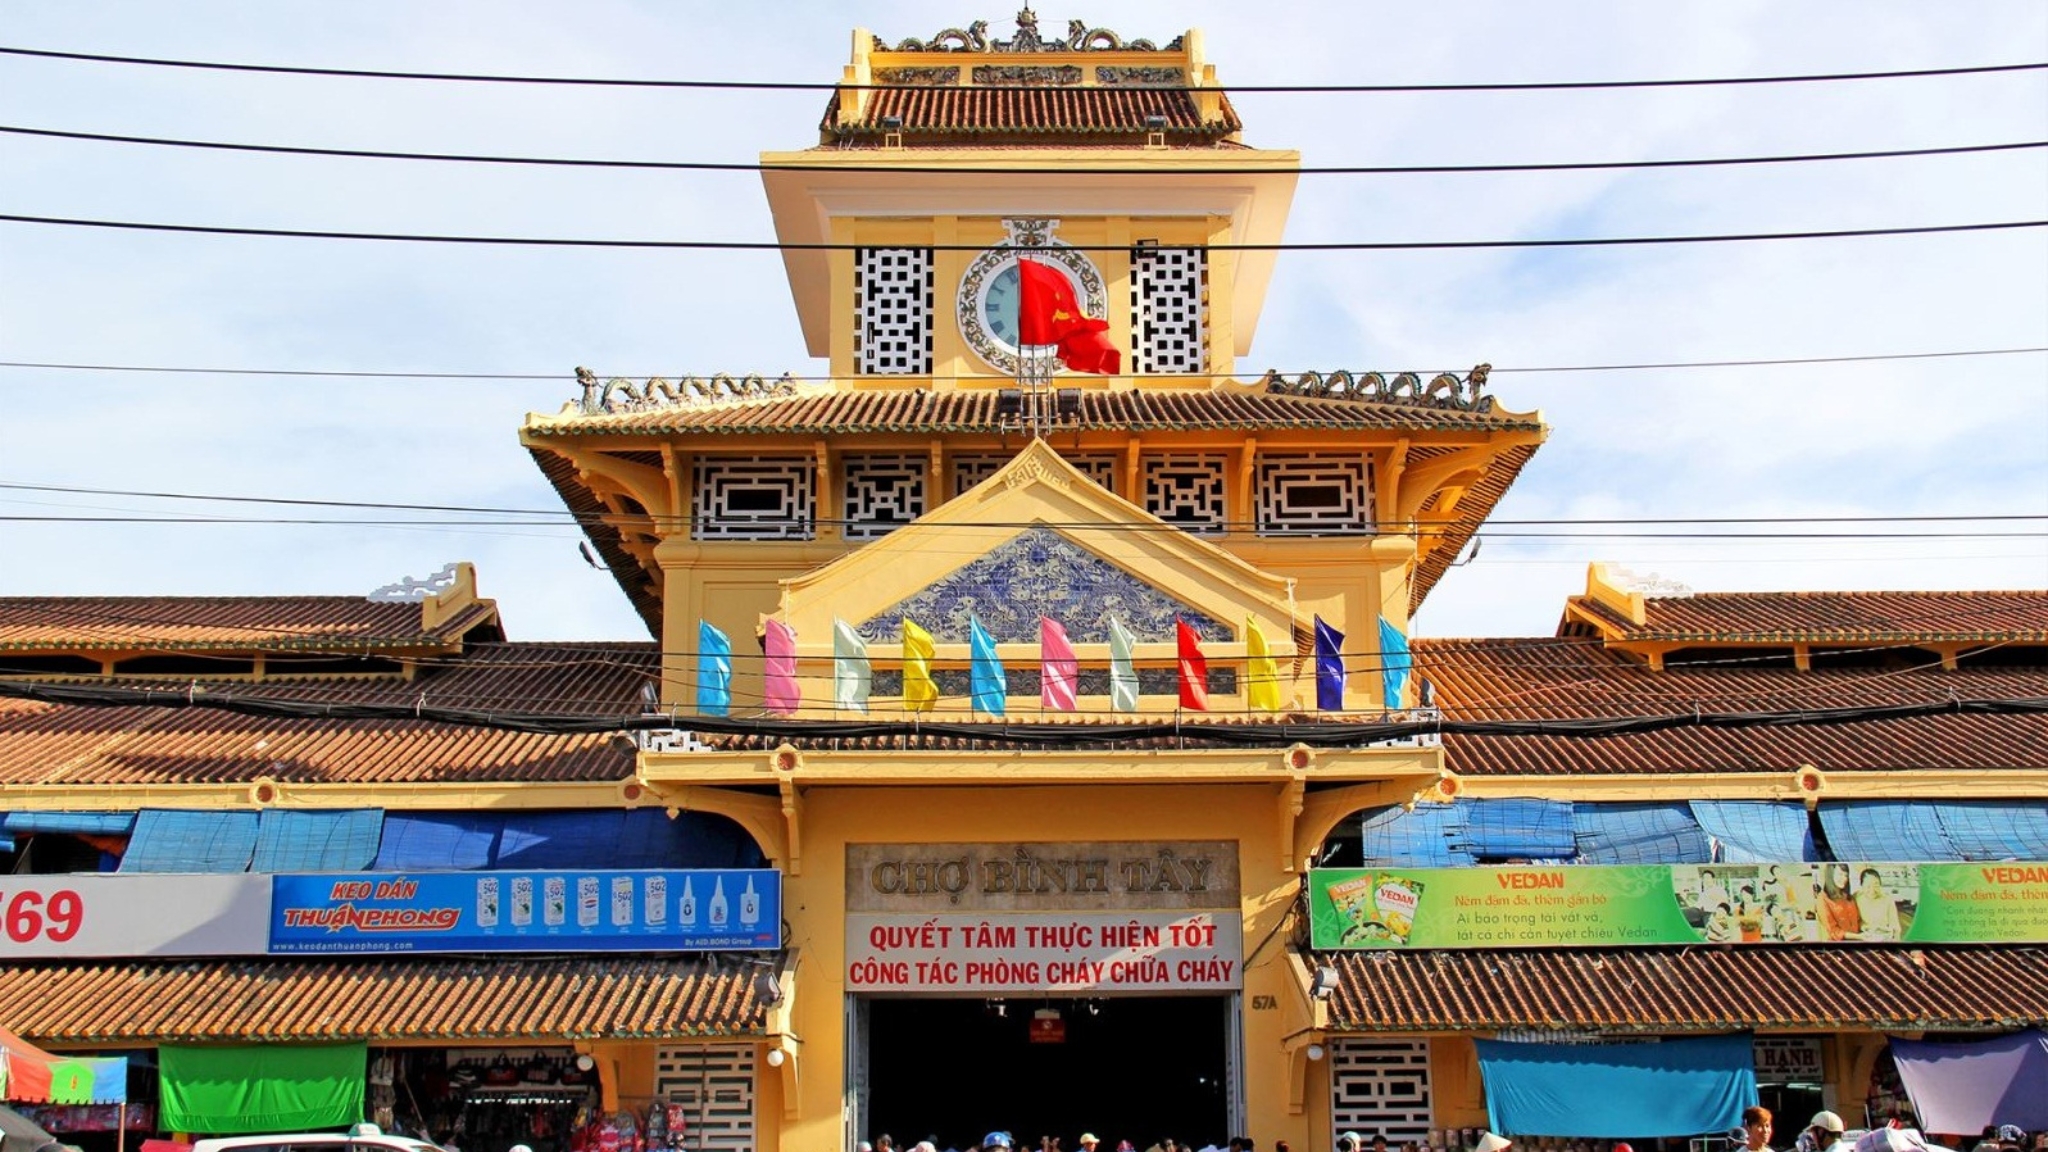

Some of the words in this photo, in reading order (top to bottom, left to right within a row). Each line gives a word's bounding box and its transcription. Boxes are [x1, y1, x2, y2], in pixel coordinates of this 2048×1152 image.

[871, 857, 971, 904] CHỢ
[982, 847, 1109, 894] BÌNH
[1120, 848, 1213, 893] TÂY
[1497, 872, 1564, 889] VEDAN
[330, 881, 372, 900] KEO
[1380, 888, 1415, 904] VEDAN
[0, 890, 84, 943] 69
[1457, 913, 1470, 924] Ai
[870, 918, 952, 951] QUYẾT
[960, 922, 1016, 948] TÂM
[1025, 922, 1093, 952] THỰC
[1101, 920, 1159, 952] HIỆN
[1168, 917, 1217, 947] TỐT
[1618, 926, 1658, 938] Vedan
[273, 942, 413, 950] www.keodanthuanphong.com
[850, 956, 908, 984] CÔNG
[915, 957, 958, 984] TÁC
[966, 957, 1040, 984] PHÒNG
[1047, 957, 1104, 984] CHÁY
[1110, 955, 1169, 984] CHỮA
[1177, 955, 1233, 982] CHÁY
[1252, 995, 1278, 1010] 57A
